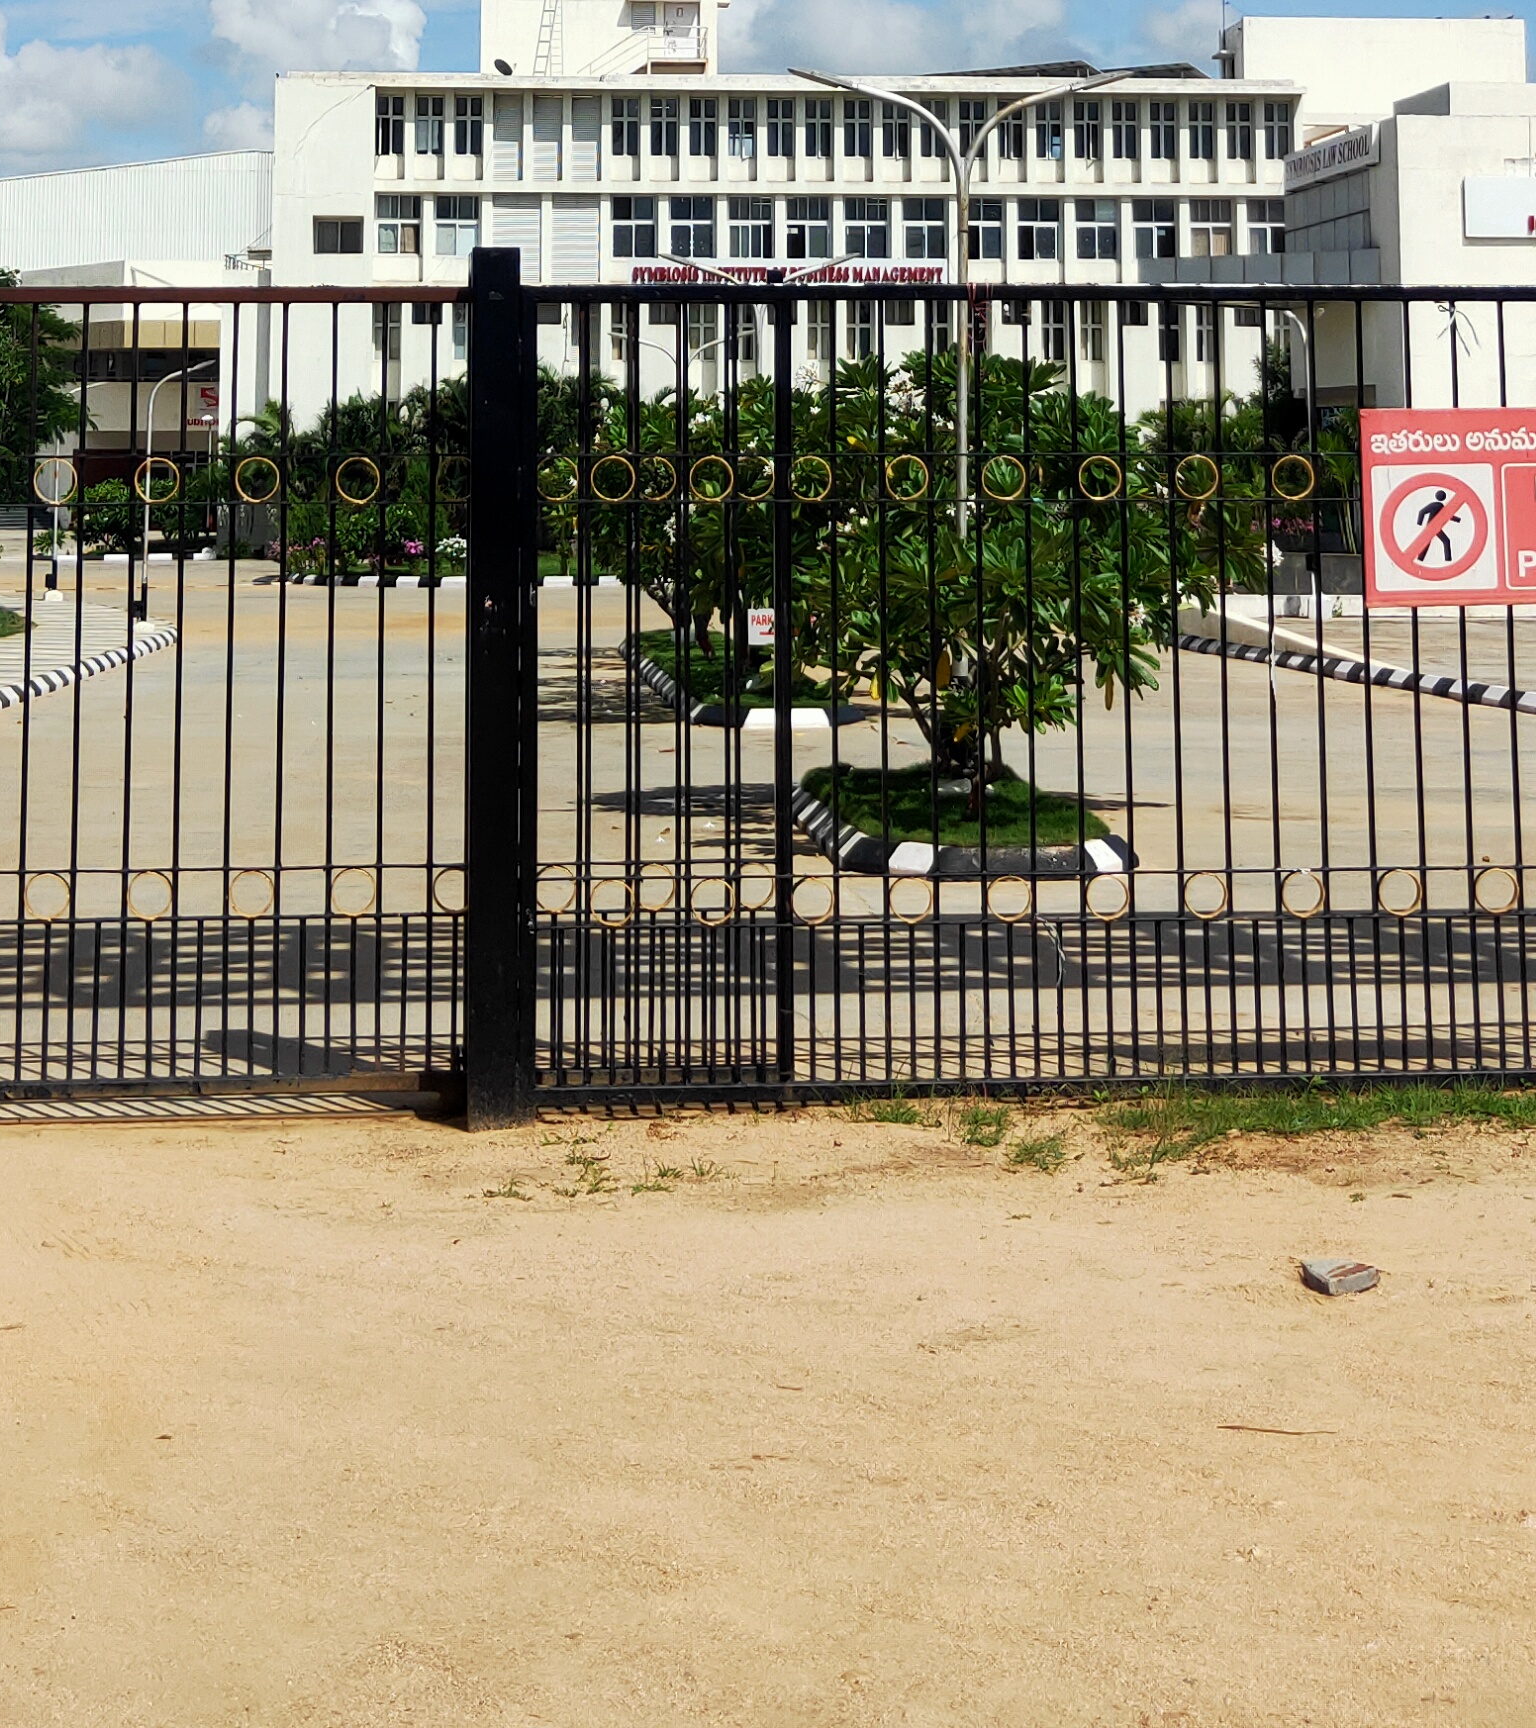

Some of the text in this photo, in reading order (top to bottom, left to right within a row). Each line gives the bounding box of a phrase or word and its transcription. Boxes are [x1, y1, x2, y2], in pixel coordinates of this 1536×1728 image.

[1337, 133, 1369, 164] SCHOOL
[632, 266, 699, 283] SYMBIOSIS
[852, 266, 943, 283] MANAGEMENT
[1370, 429, 1461, 454] ఇతరులు
